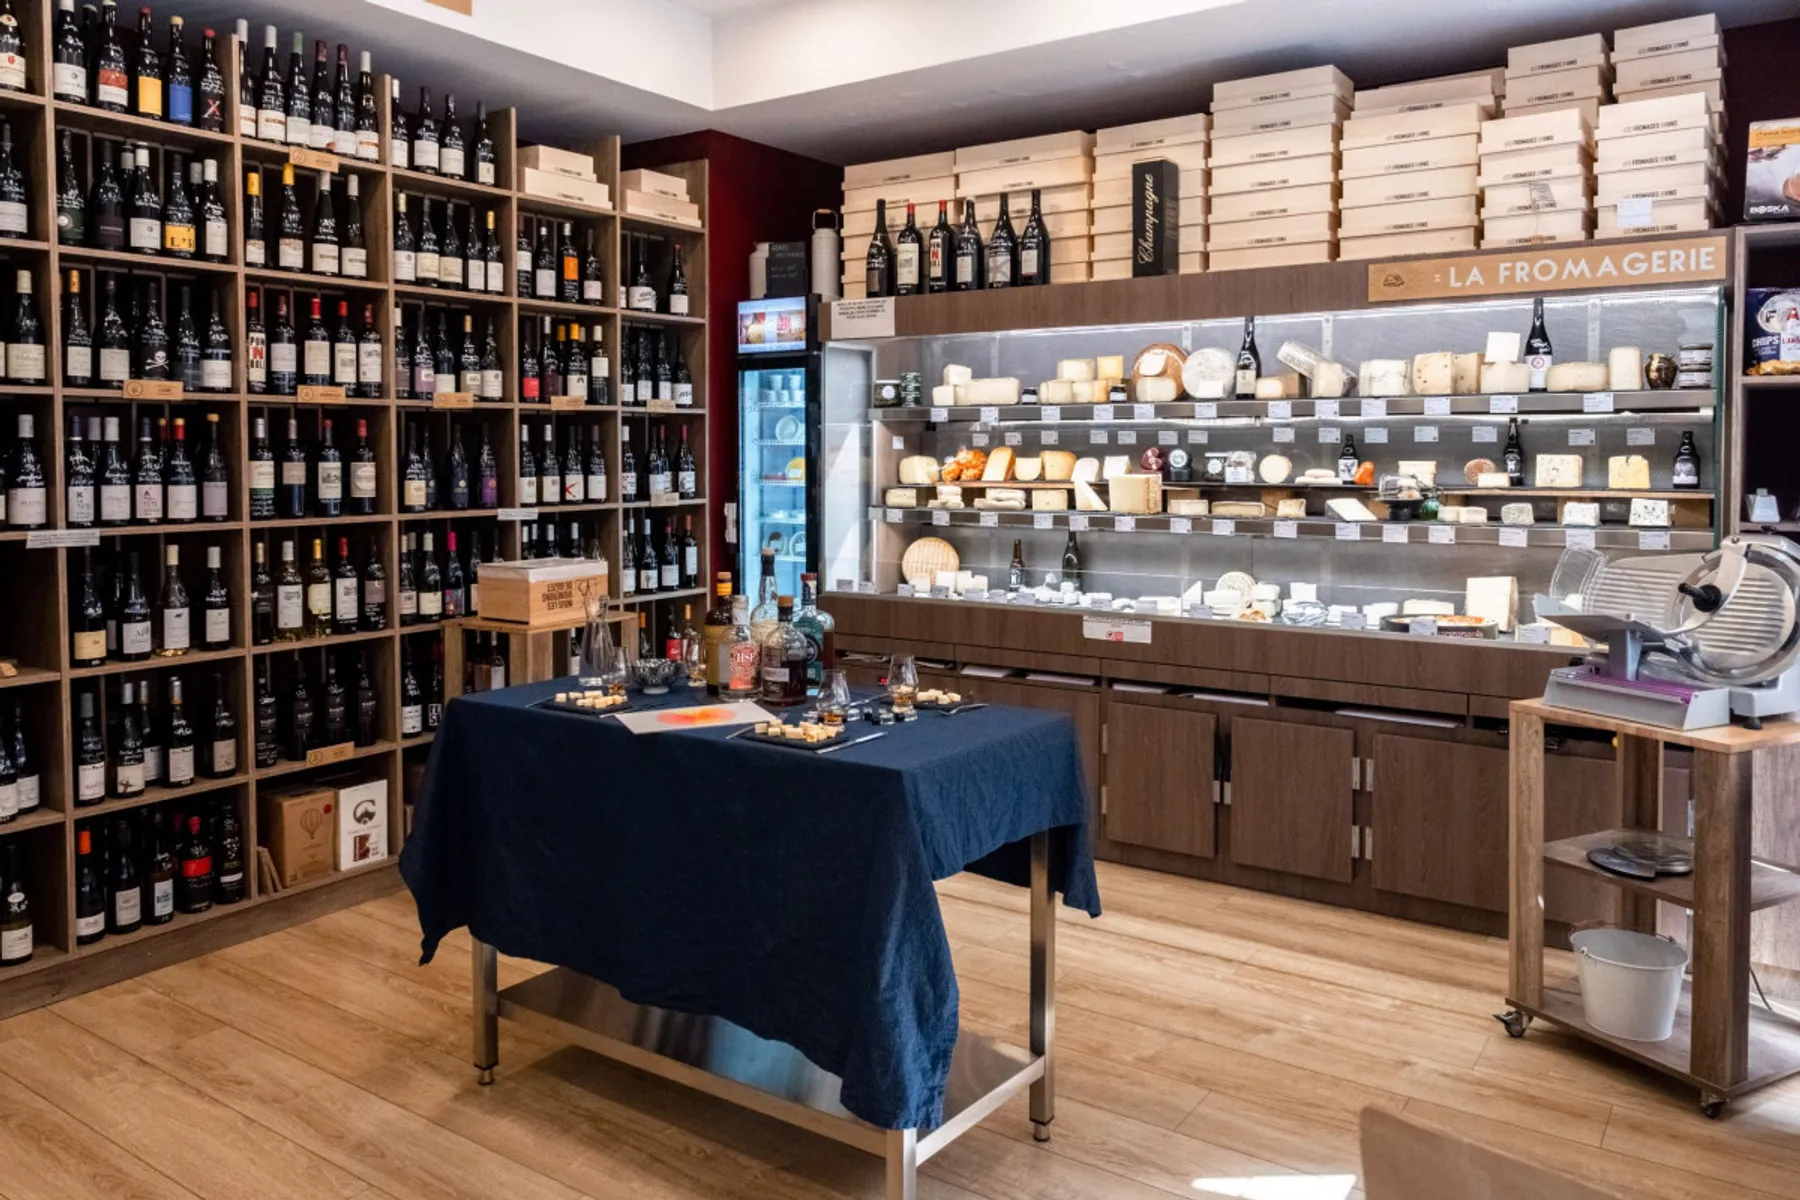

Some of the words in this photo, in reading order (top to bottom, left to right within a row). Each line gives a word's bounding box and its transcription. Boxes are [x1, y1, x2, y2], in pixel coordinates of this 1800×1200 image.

[1138, 173, 1159, 264] Champagne
[1750, 205, 1789, 214] BOSKA
[1450, 266, 1485, 287] LA
[1498, 246, 1715, 284] FROMAGERIE
[1752, 336, 1780, 348] CHIPS
